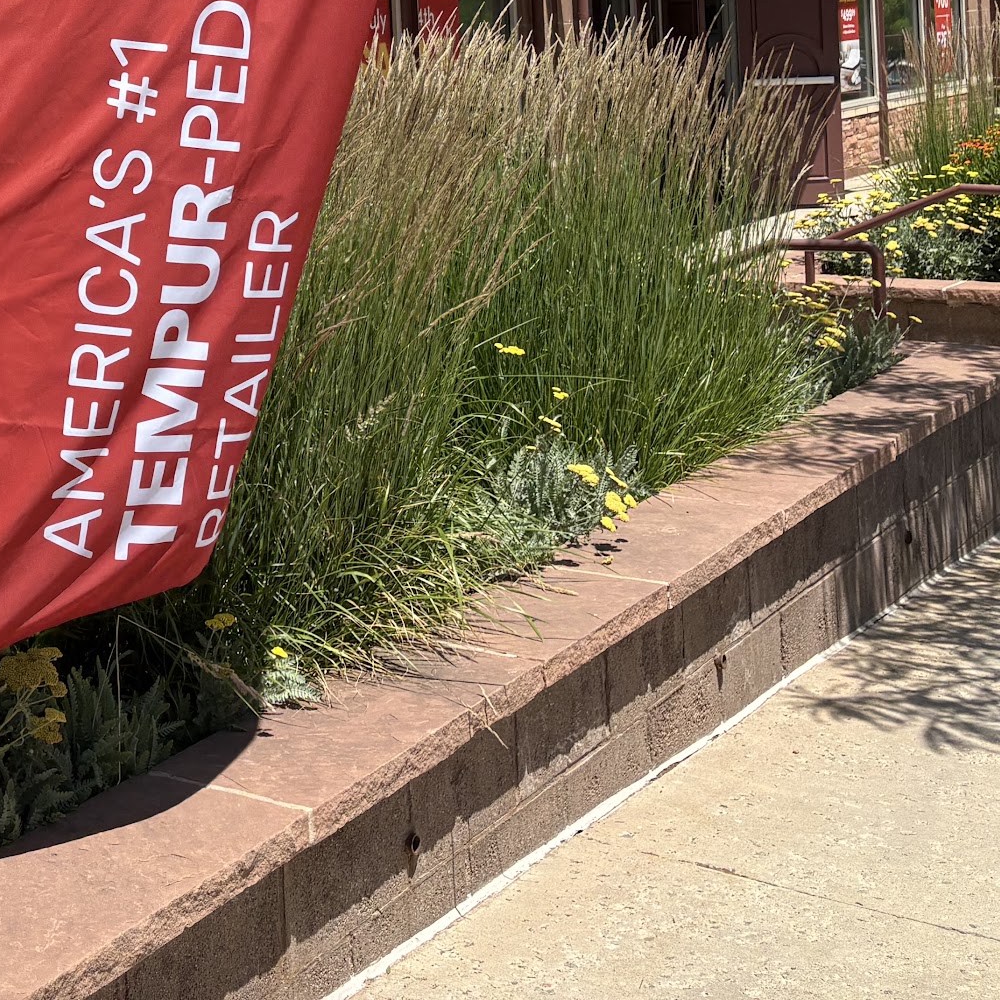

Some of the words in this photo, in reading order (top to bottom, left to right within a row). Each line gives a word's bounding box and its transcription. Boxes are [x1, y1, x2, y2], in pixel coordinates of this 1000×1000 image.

[369, 8, 387, 35] uly
[44, 148, 153, 559] AMERICA'S
[107, 39, 169, 124] #1
[195, 211, 299, 548] RETAILER
